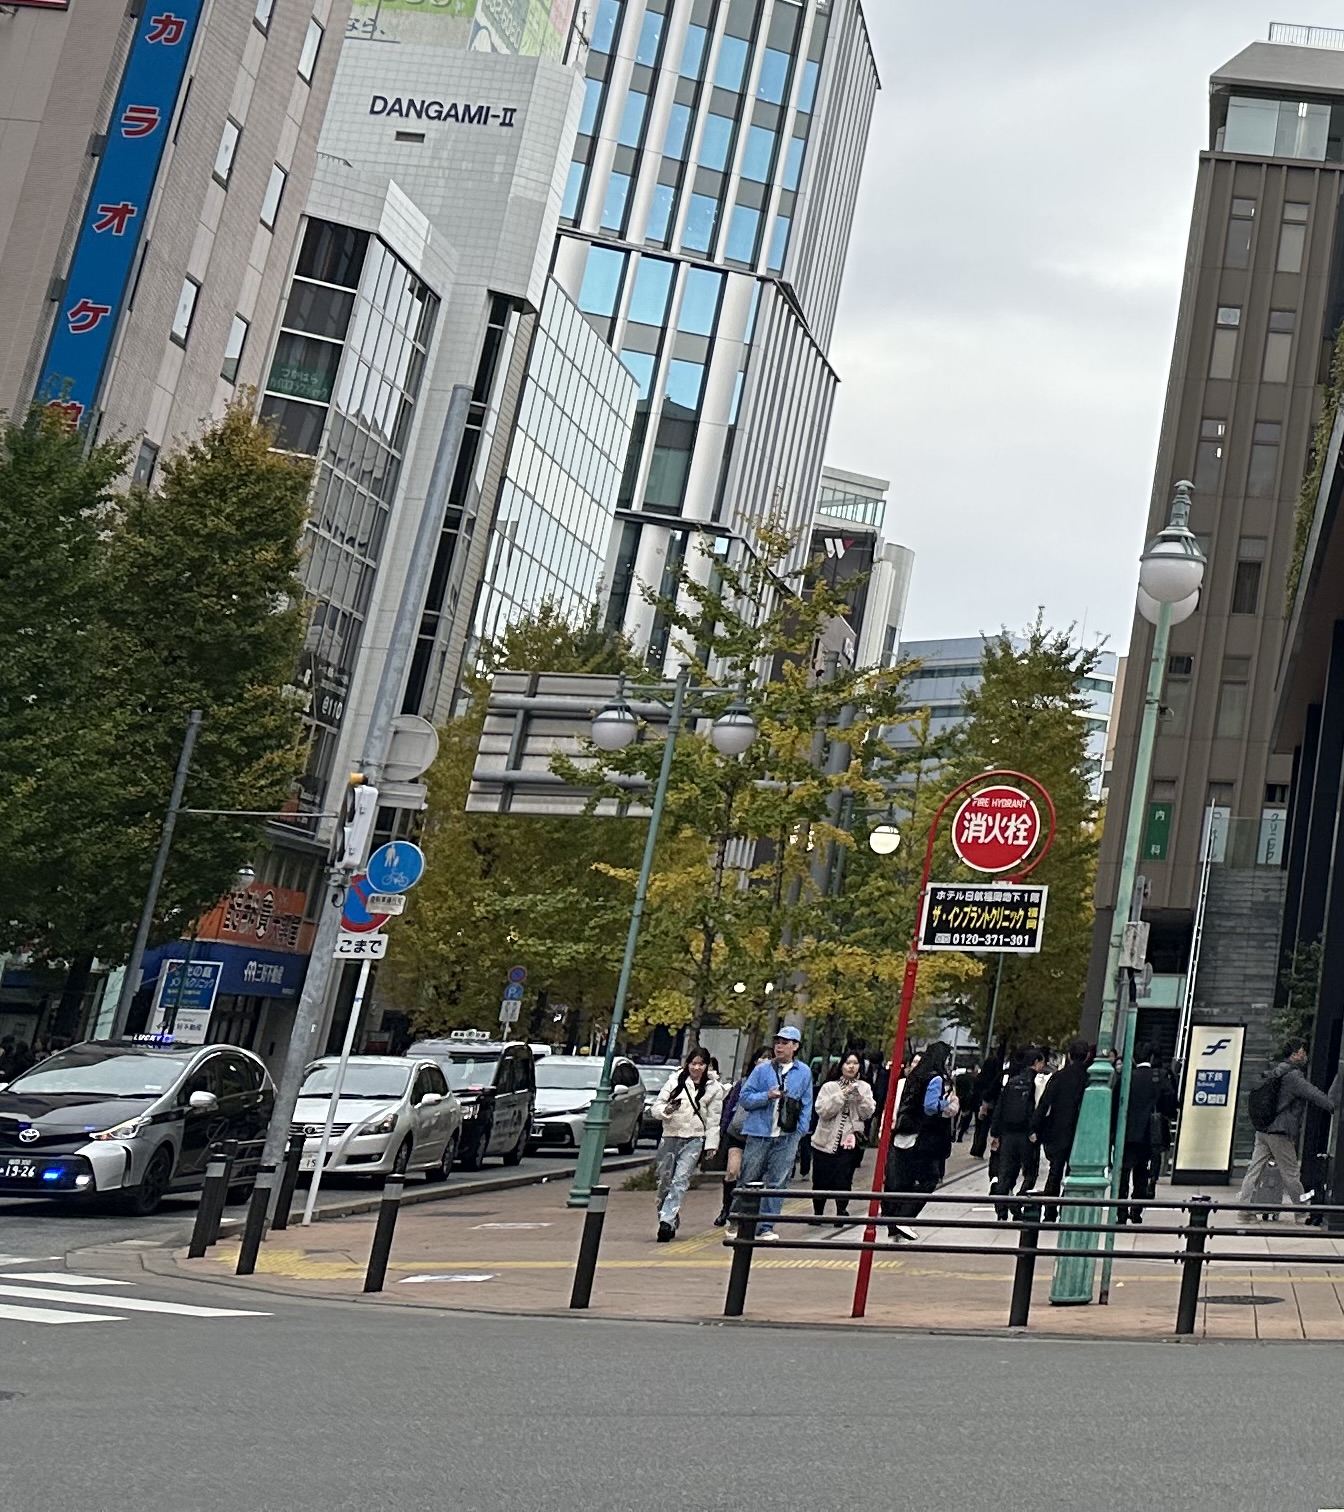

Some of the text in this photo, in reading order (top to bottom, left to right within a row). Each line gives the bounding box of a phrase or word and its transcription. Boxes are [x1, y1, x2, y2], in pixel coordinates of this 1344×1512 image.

[971, 797, 990, 808] FIRE
[960, 811, 1032, 846] 消火栓
[333, 939, 383, 954] こまで
[952, 933, 1029, 947] 0120-371-301
